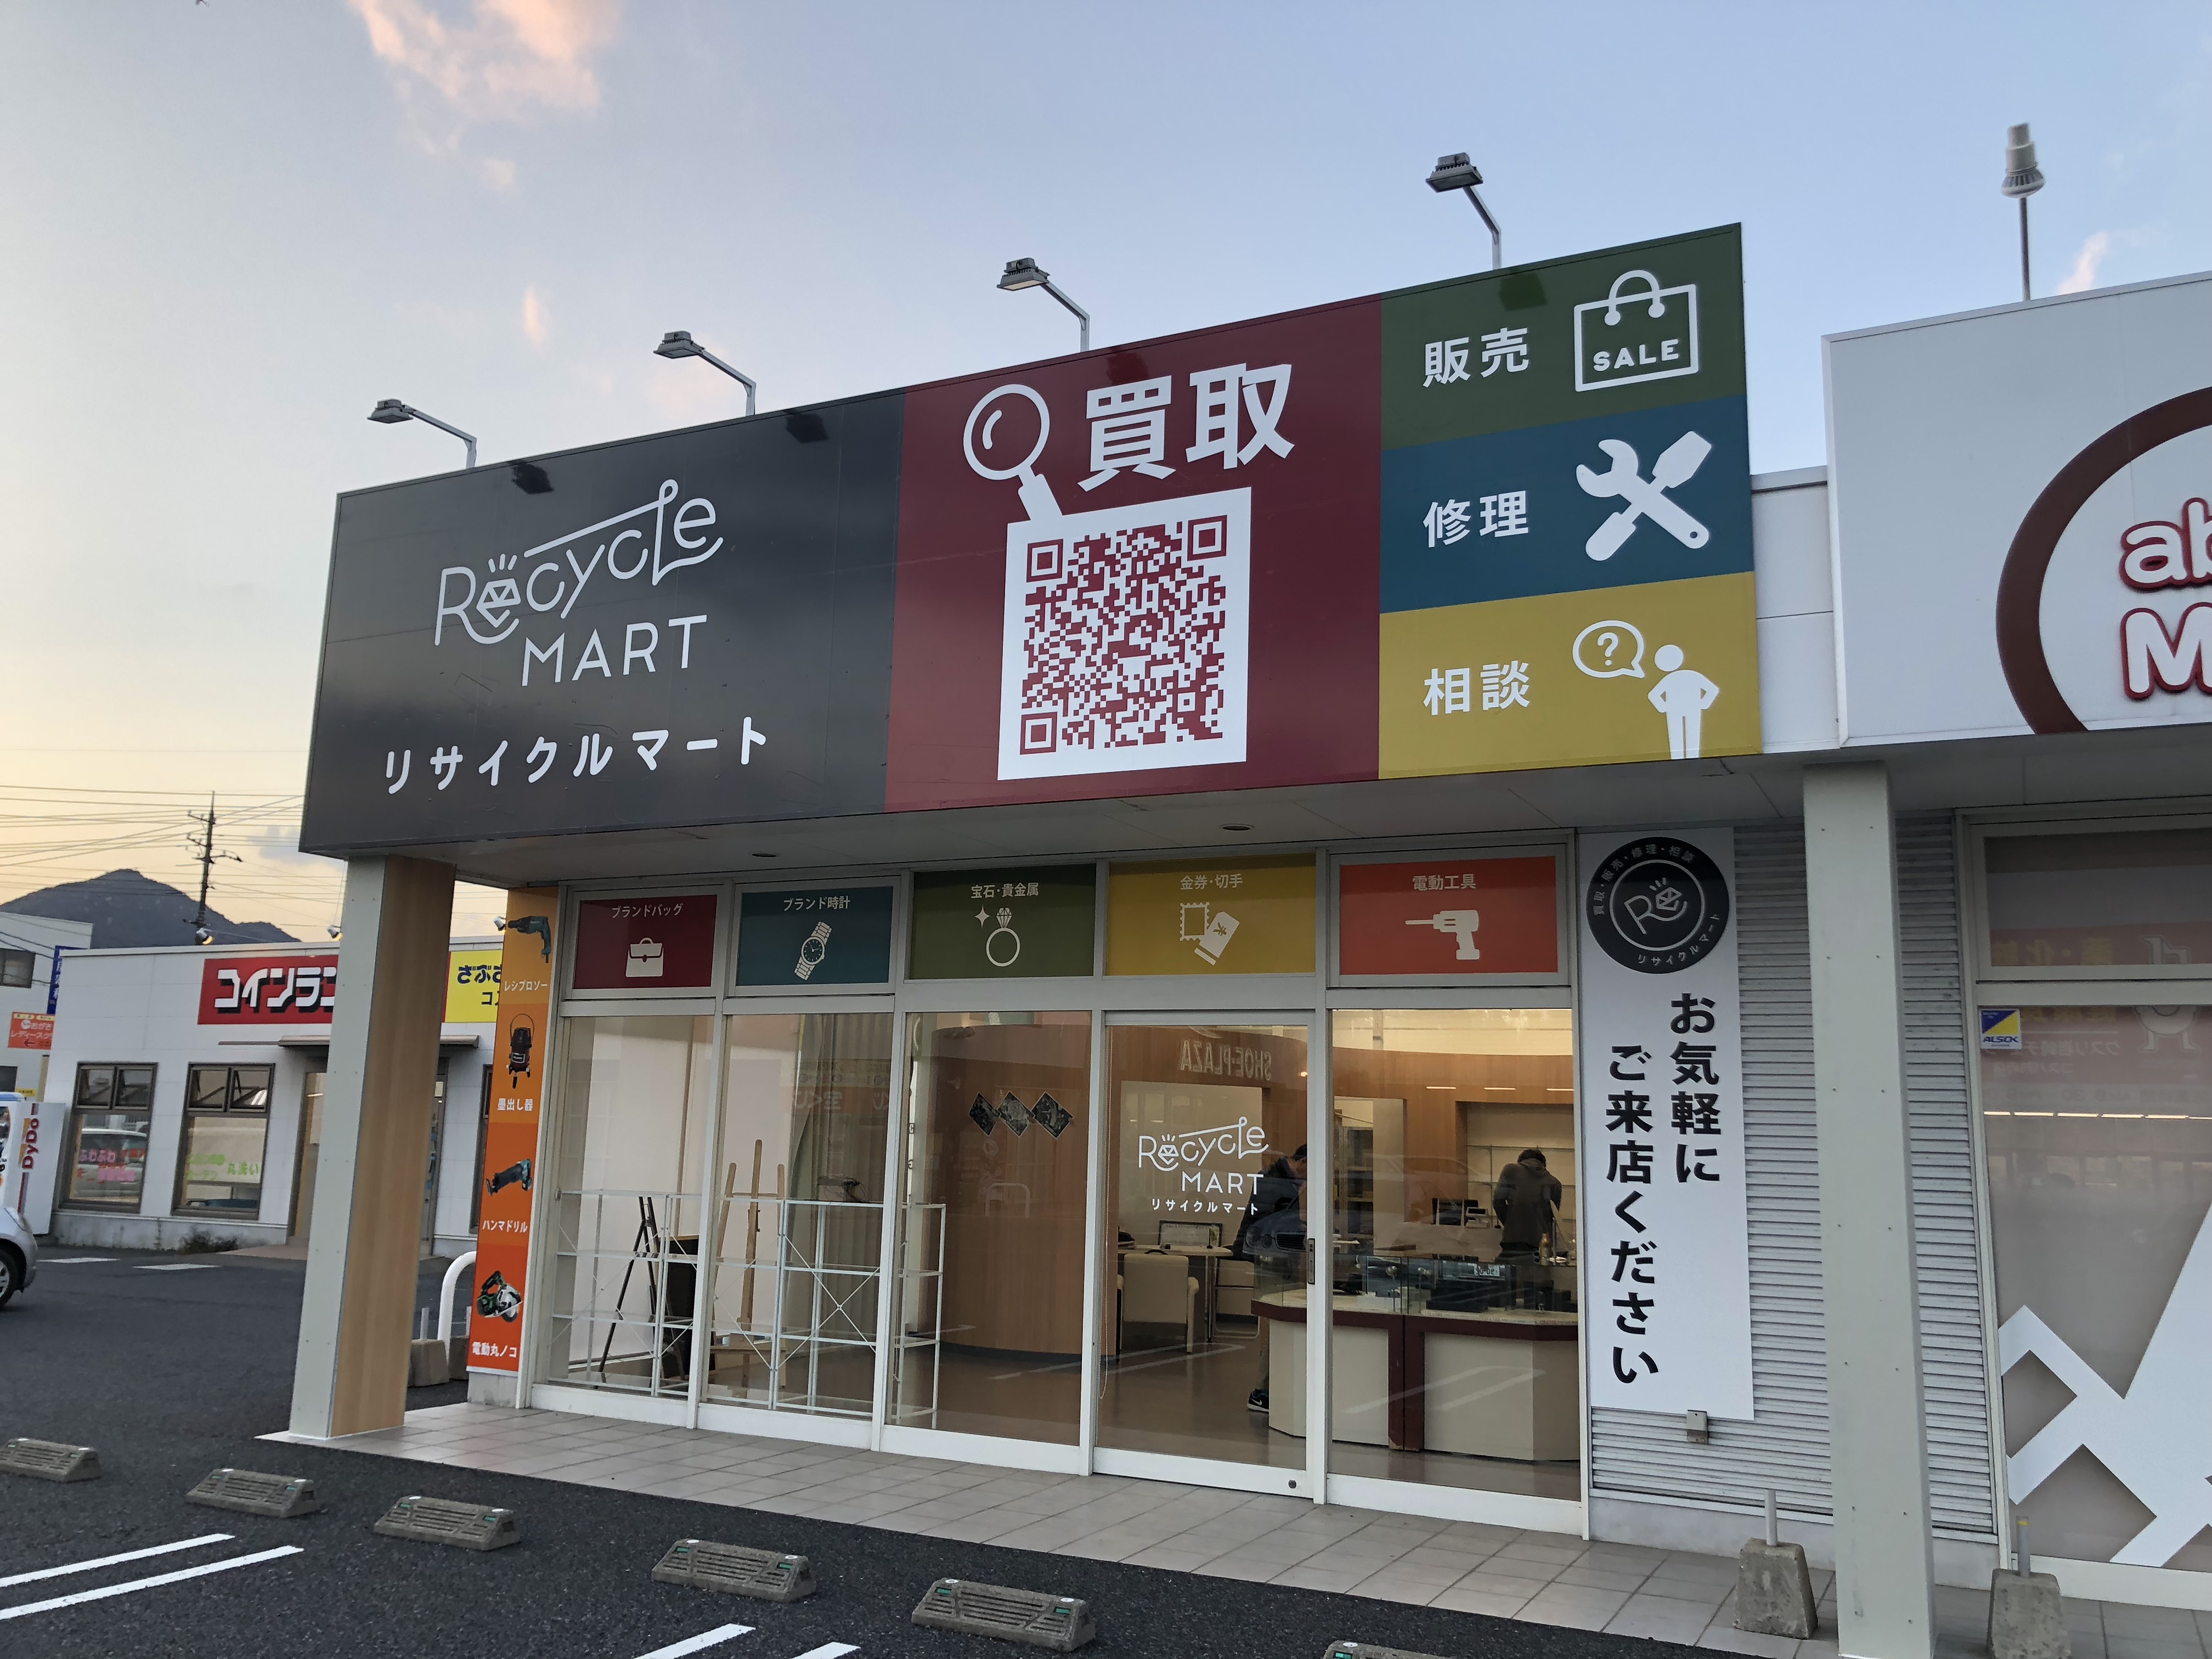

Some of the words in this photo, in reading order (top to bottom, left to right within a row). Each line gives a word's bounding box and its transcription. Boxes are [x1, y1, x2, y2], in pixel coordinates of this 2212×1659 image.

[1423, 326, 1530, 388] 販売
[1593, 338, 1679, 371] SALE
[1077, 363, 1295, 492] 買取
[1423, 489, 1529, 548] 修理
[521, 614, 708, 687] MART
[1423, 660, 1531, 716] 相談
[386, 716, 767, 794] リサイクルマート
[970, 882, 1039, 899] 宝石・貴金属
[1180, 873, 1243, 890] 金券・切手
[1412, 874, 1476, 892] 電動工具
[611, 902, 684, 918] ブランドバッグ
[783, 896, 850, 912] ブランド時計
[1638, 914, 1720, 966] リサイクルマート
[504, 980, 548, 992] レシプロソー
[1668, 992, 1722, 1183] お気軽に
[22, 1118, 40, 1170] DyDo
[1181, 1170, 1264, 1195] MART
[482, 1220, 528, 1233] ハンマドリル
[1152, 1198, 1259, 1216] リサイクルマート
[1605, 1045, 1659, 1384] ご来店ください
